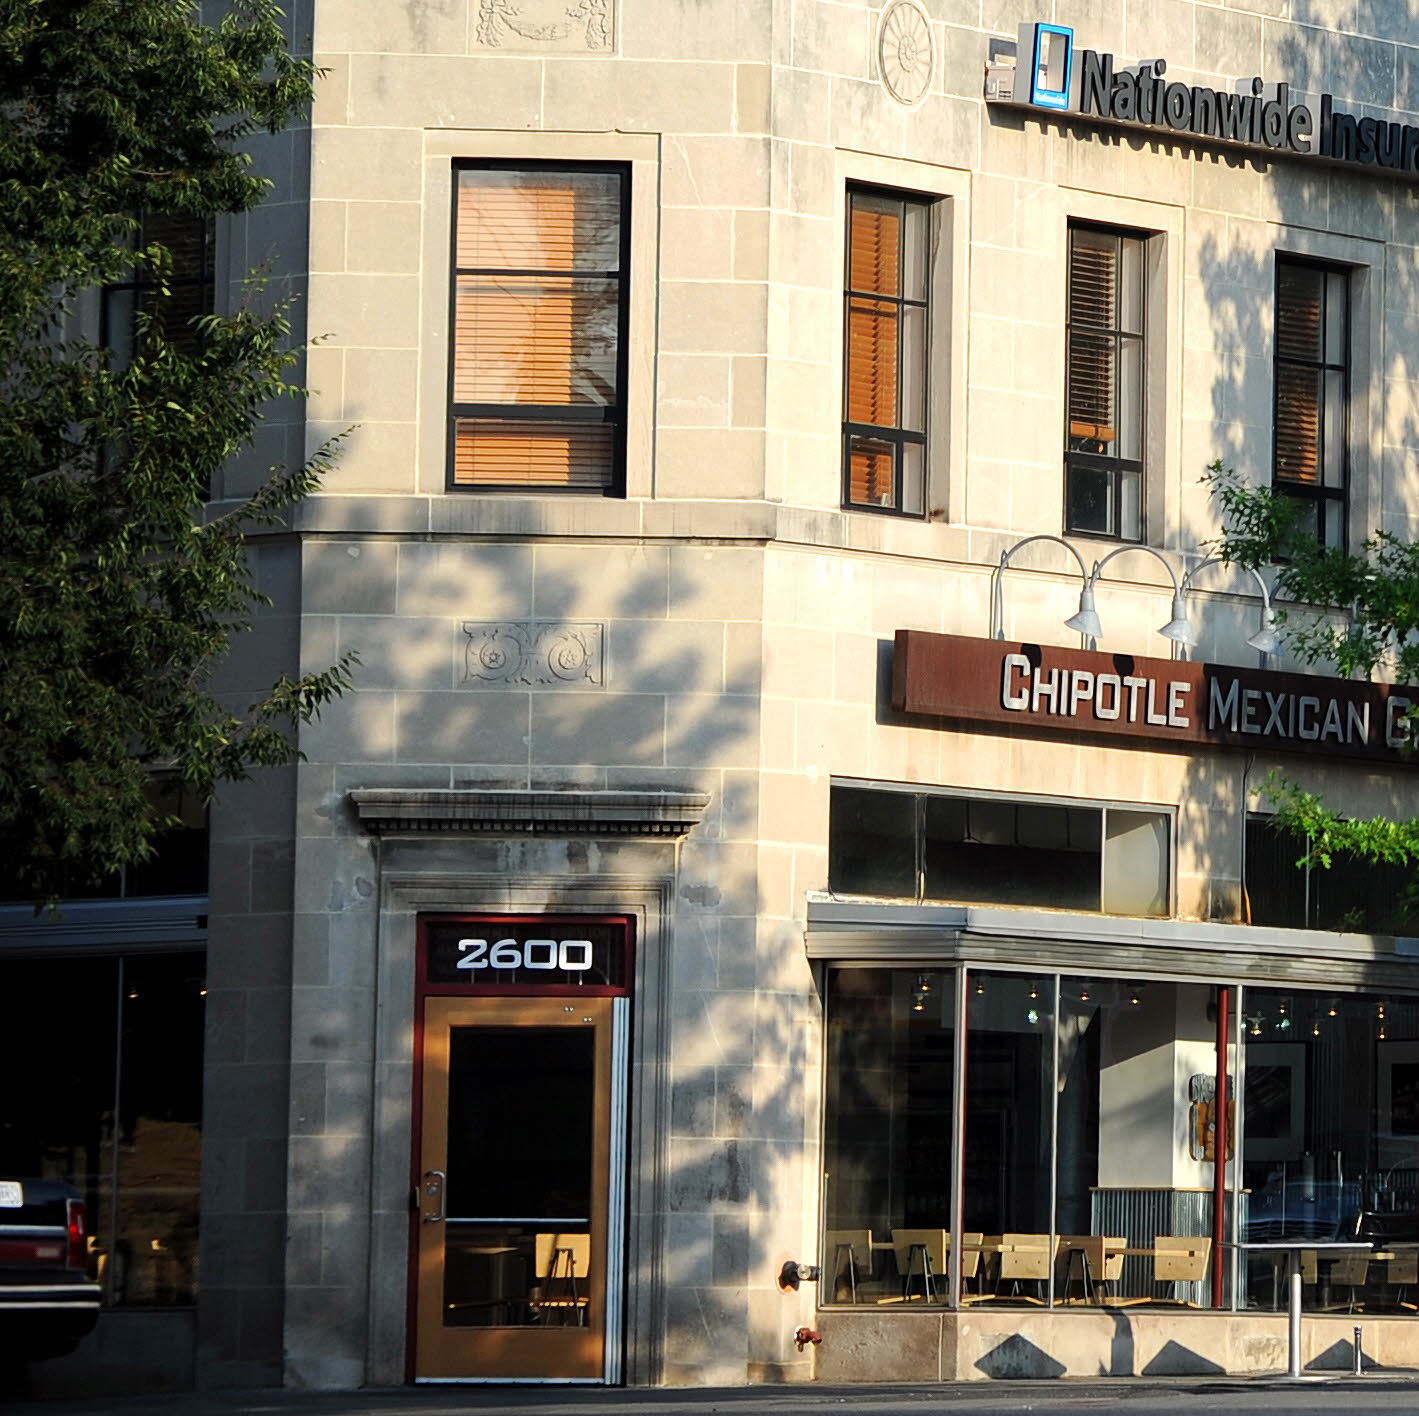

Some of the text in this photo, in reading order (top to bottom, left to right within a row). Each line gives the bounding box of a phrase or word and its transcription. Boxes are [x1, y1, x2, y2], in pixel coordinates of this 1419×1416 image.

[1081, 49, 1312, 153] Nationwide
[1003, 653, 1191, 728] CHIPOTLE
[1208, 676, 1370, 745] MEXICAN
[456, 938, 593, 971] 2600
